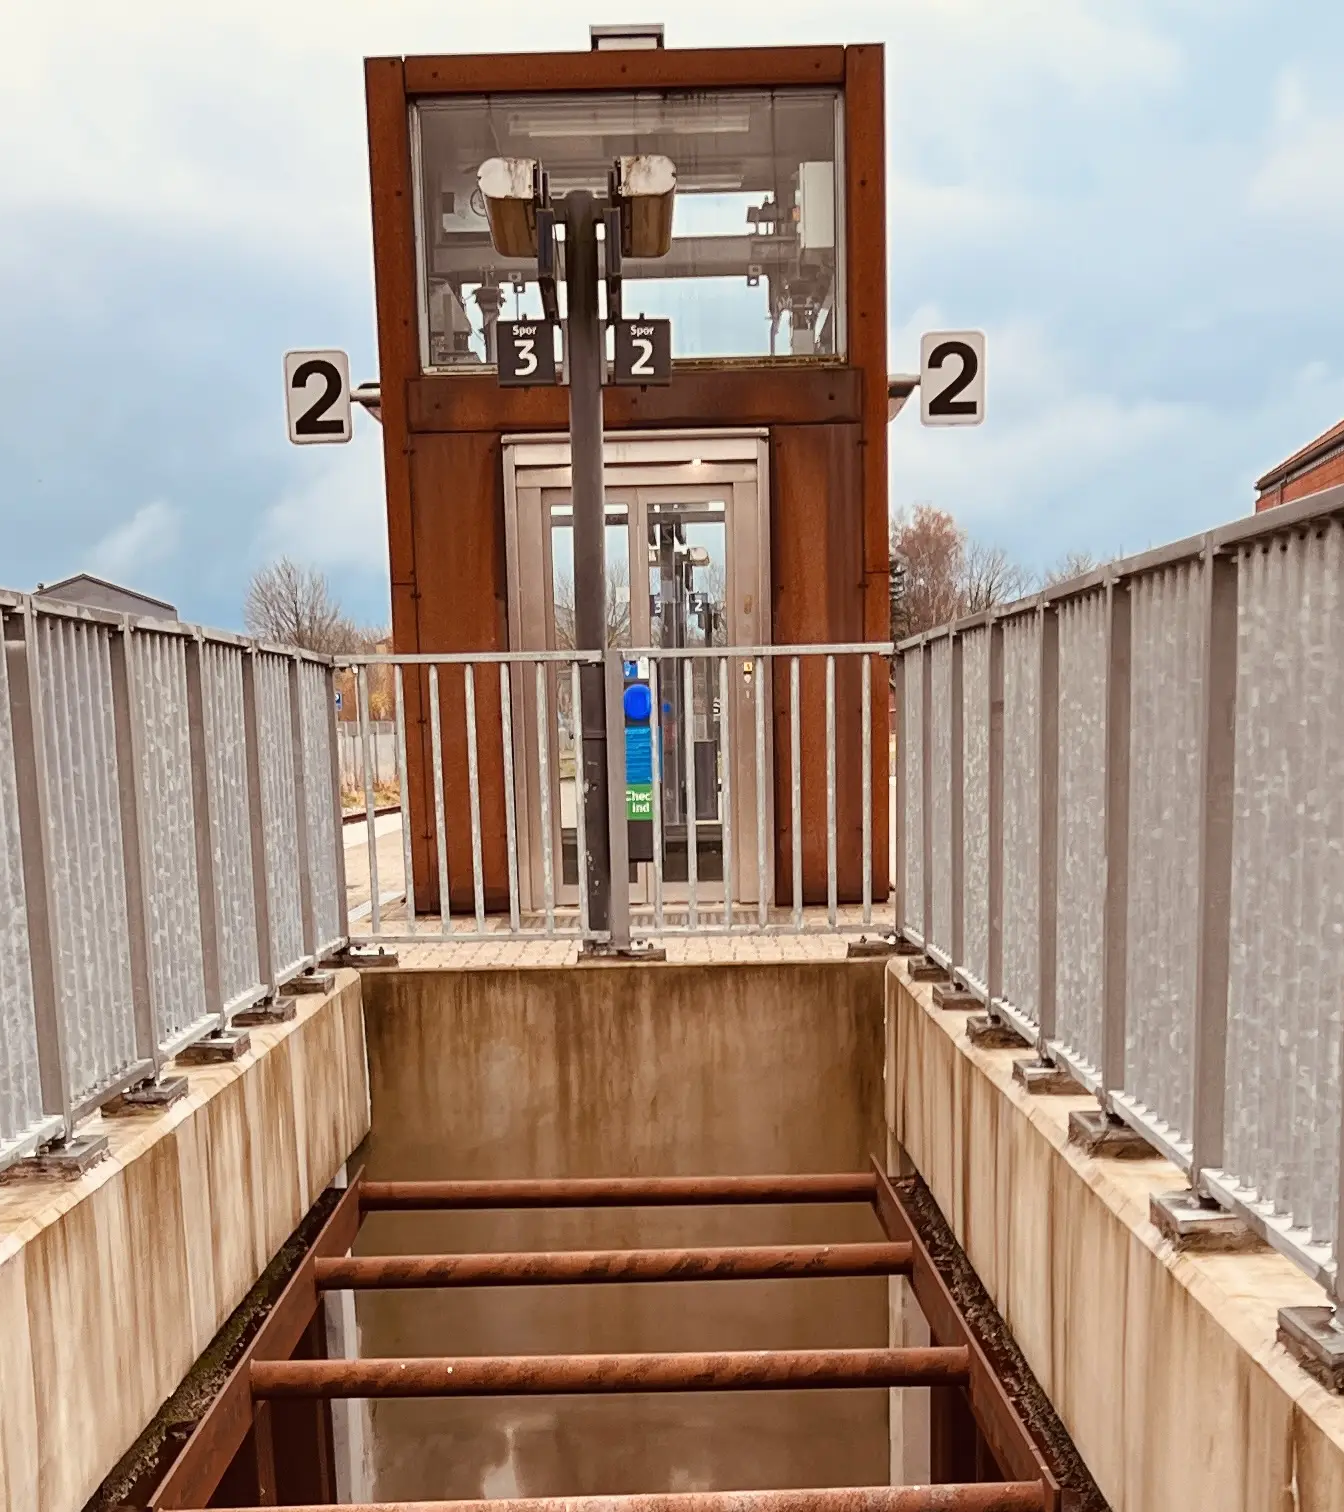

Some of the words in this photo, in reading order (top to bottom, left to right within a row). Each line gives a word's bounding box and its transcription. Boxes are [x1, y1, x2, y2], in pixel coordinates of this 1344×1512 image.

[512, 324, 538, 337] Spor
[630, 324, 655, 337] Spor
[514, 339, 538, 376] 3
[630, 338, 655, 375] 2
[291, 359, 345, 435] 2
[927, 341, 978, 416] 2
